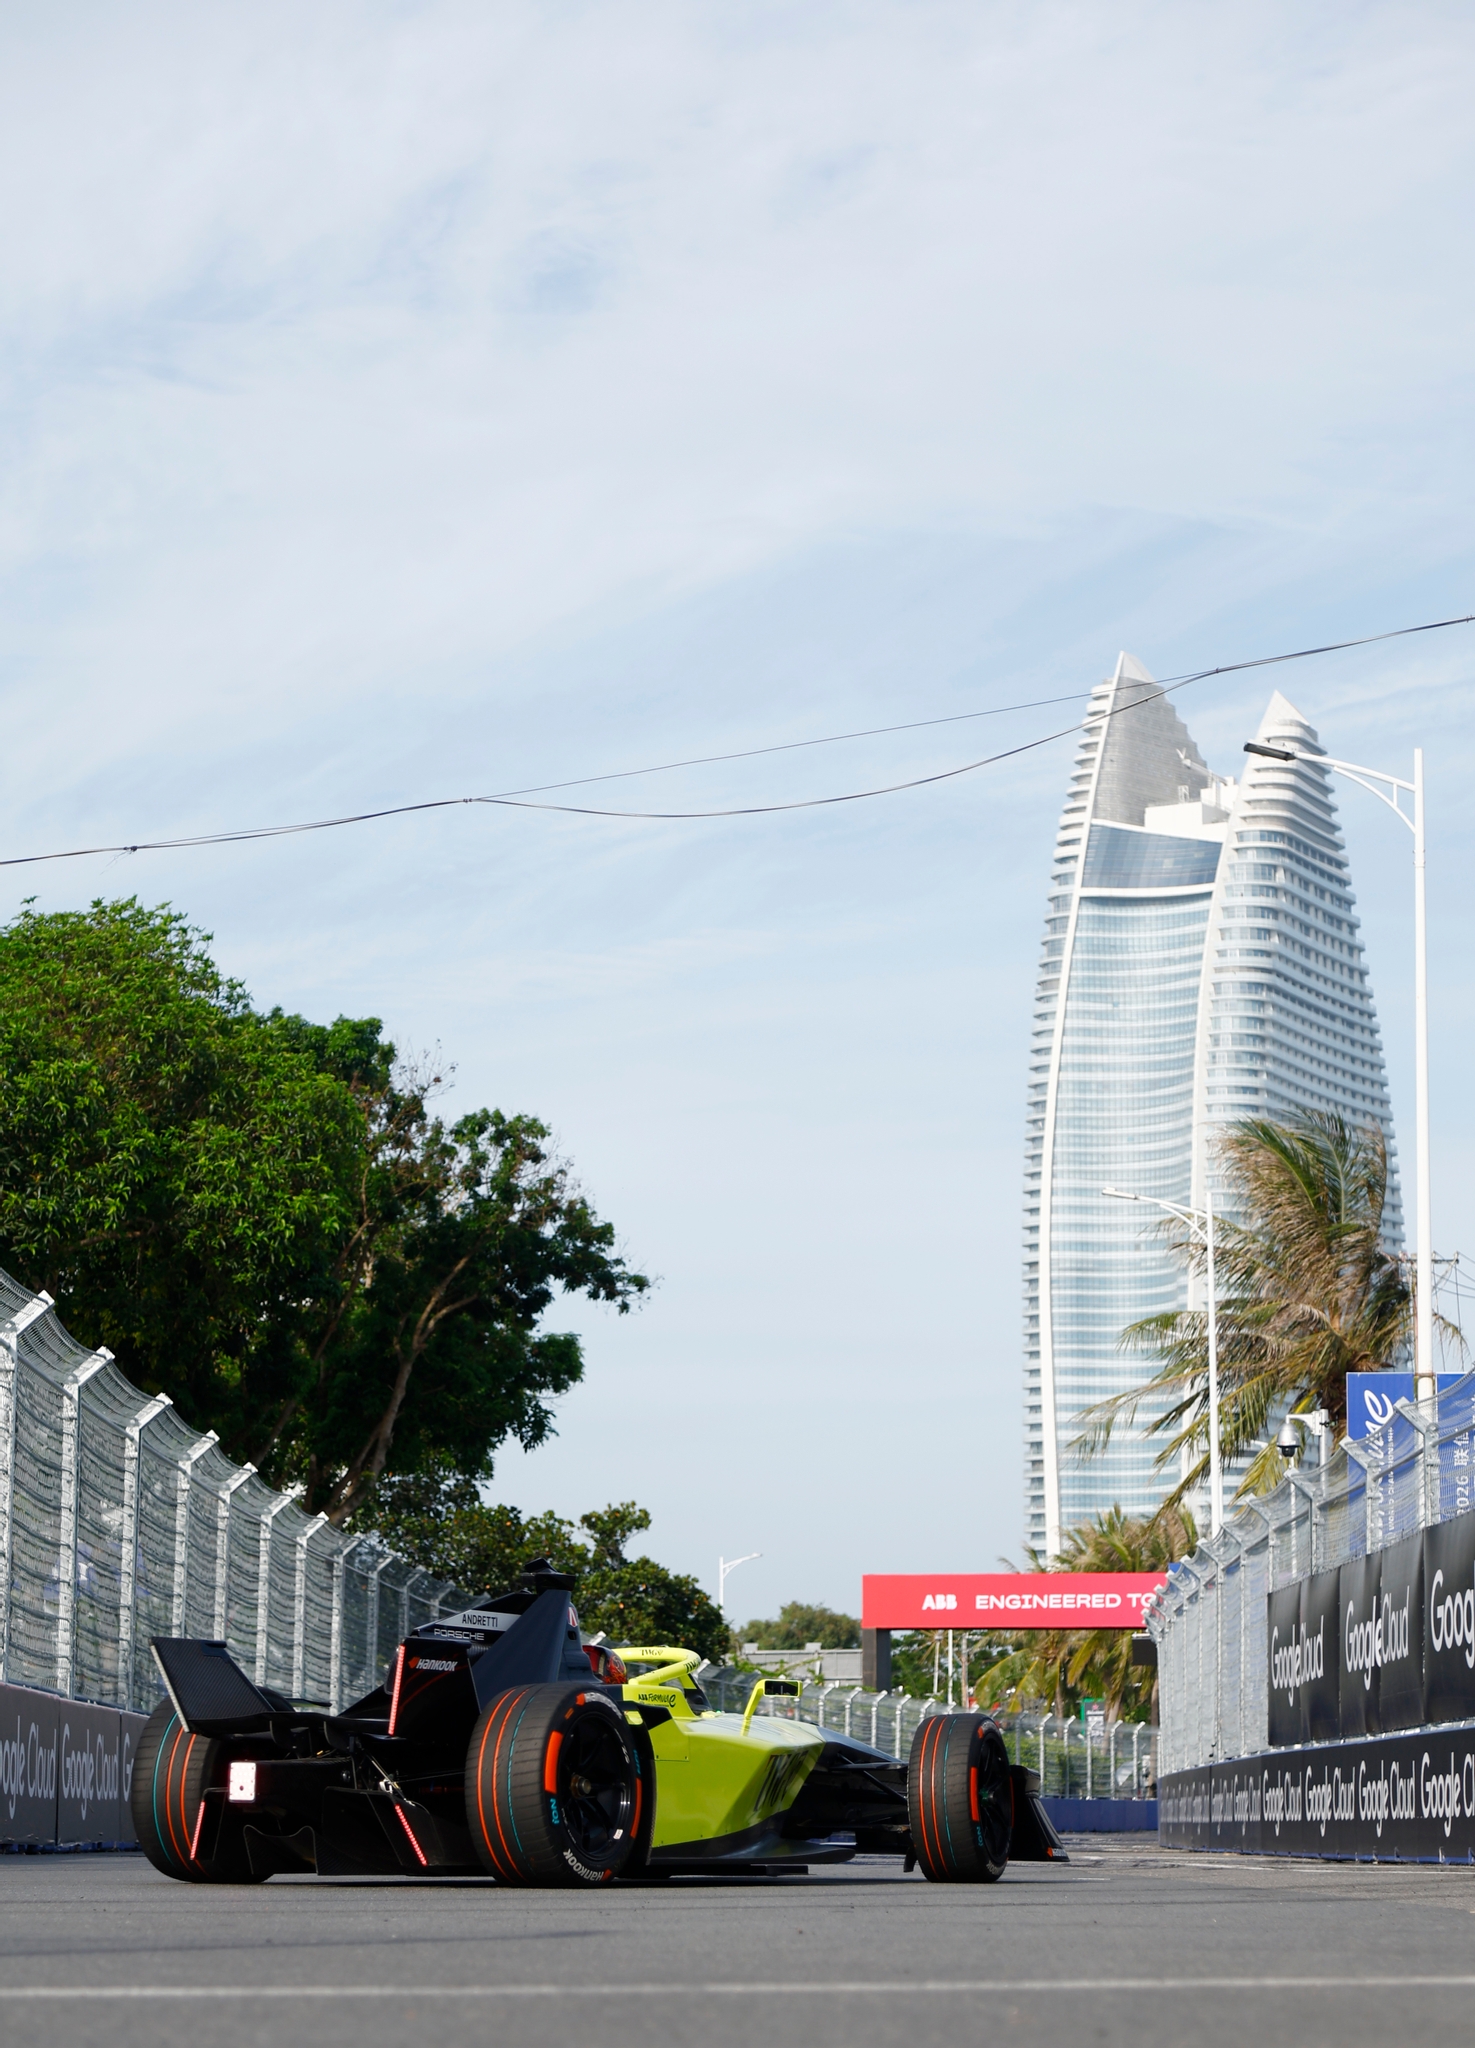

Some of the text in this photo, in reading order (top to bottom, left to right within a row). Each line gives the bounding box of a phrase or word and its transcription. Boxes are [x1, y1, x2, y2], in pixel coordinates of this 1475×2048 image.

[433, 1628, 485, 1641] PORSCHE
[461, 1613, 498, 1628] ANDRETTI
[922, 1594, 958, 1610] ABB
[975, 1593, 1122, 1609] ENGINEERED
[1345, 1585, 1410, 1691] Google Cloud
[1430, 1568, 1475, 1669] Goog
[1271, 1624, 1301, 1708] Google
[0, 1715, 26, 1820] ogle
[27, 1722, 57, 1800] Cloud
[61, 1723, 95, 1821] Google
[95, 1733, 119, 1800] Cloud
[1263, 1769, 1284, 1837] Google
[1284, 1770, 1302, 1822] Cloud
[1305, 1765, 1332, 1838] Google
[1332, 1766, 1355, 1821] Cloud
[1359, 1760, 1389, 1838] Google
[1390, 1760, 1415, 1820] Cloud
[1420, 1751, 1461, 1838] Google
